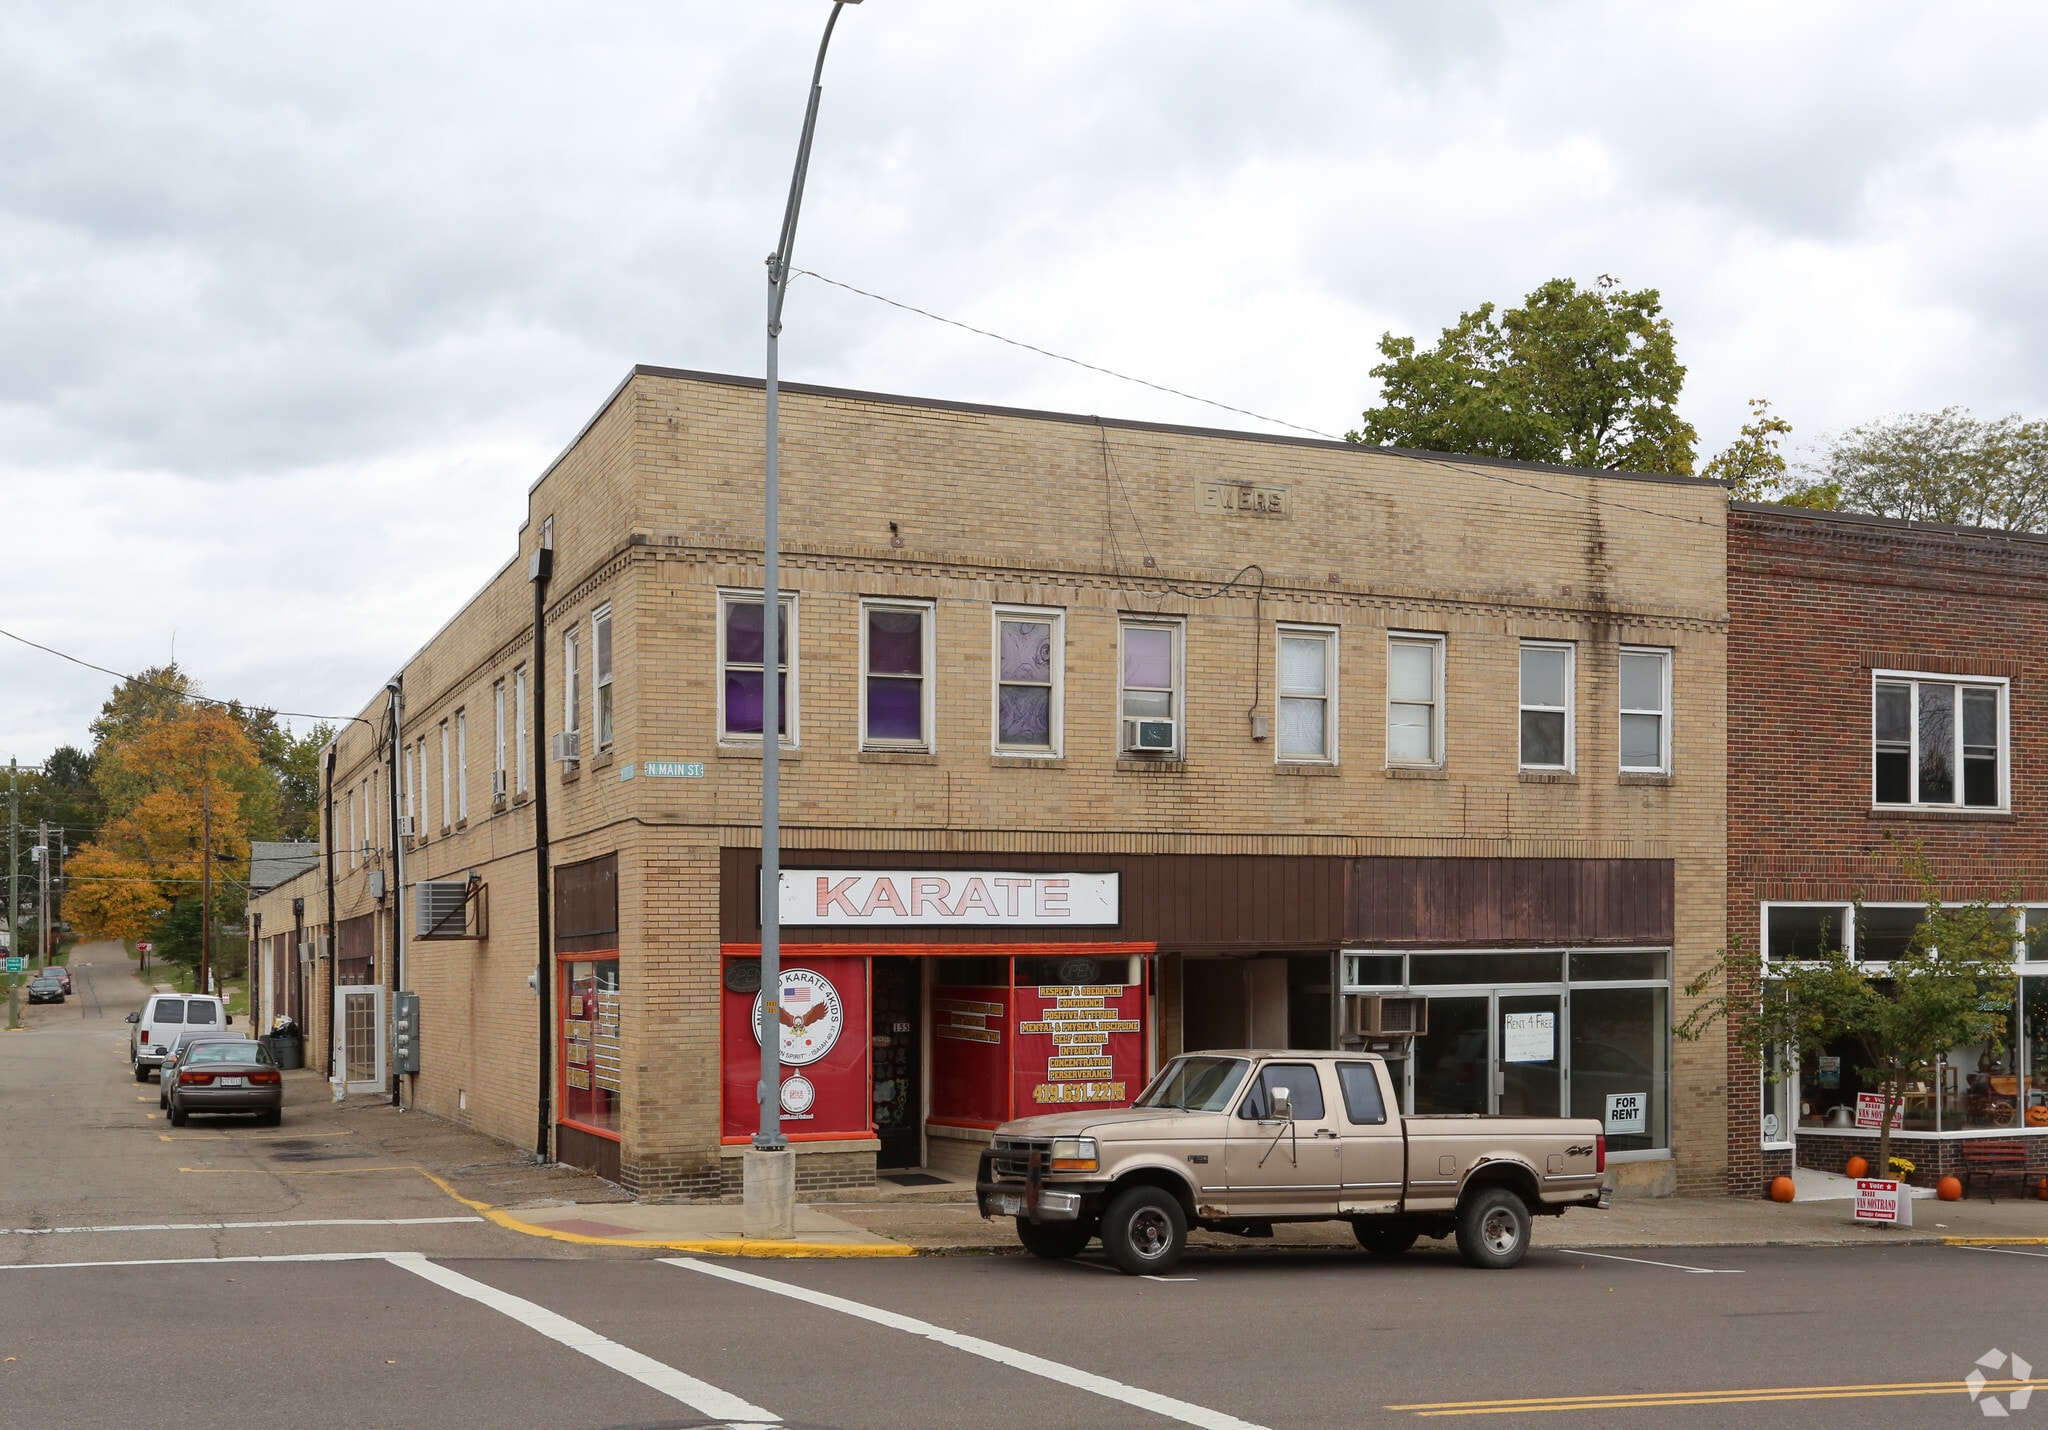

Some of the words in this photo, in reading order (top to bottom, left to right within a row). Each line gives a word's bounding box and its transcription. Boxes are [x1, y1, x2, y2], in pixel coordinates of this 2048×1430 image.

[659, 764, 685, 776] MAIN
[816, 876, 1071, 917] KARATE
[1040, 987, 1074, 997] RESPECT
[1074, 987, 1081, 997] &
[1081, 986, 1121, 995] OBEDIENCE
[785, 973, 827, 991] KARATE
[826, 991, 840, 1023] 4KIDS
[1058, 998, 1104, 1008] CONFIDENCE
[1044, 1010, 1079, 1020] POSITIVE
[1080, 1009, 1117, 1020] ATTITUDE
[895, 1023, 909, 1031] 155
[1021, 1023, 1053, 1033] MENTAL
[1055, 1023, 1061, 1032] &
[1062, 1022, 1098, 1032] PHYSICAL
[1098, 1021, 1139, 1031] DISCIPLINE
[1528, 1015, 1534, 1029] 4
[1053, 1034, 1072, 1044] SELF
[1073, 1033, 1107, 1043] CONTROL
[811, 1040, 829, 1056] ISAIAH
[1060, 1045, 1101, 1056] INTEGRITY
[1050, 1057, 1111, 1068] CONCENTRATION
[1049, 1069, 1111, 1080] PERSERVERANCE
[1032, 1082, 1126, 1103] 419.631.2215
[1616, 1097, 1636, 1108] FOR
[1611, 1108, 1640, 1120] RENT
[1869, 1182, 1884, 1190] Vote
[1856, 1198, 1866, 1208] VAN
[1867, 1199, 1896, 1210] NOSTRAND
